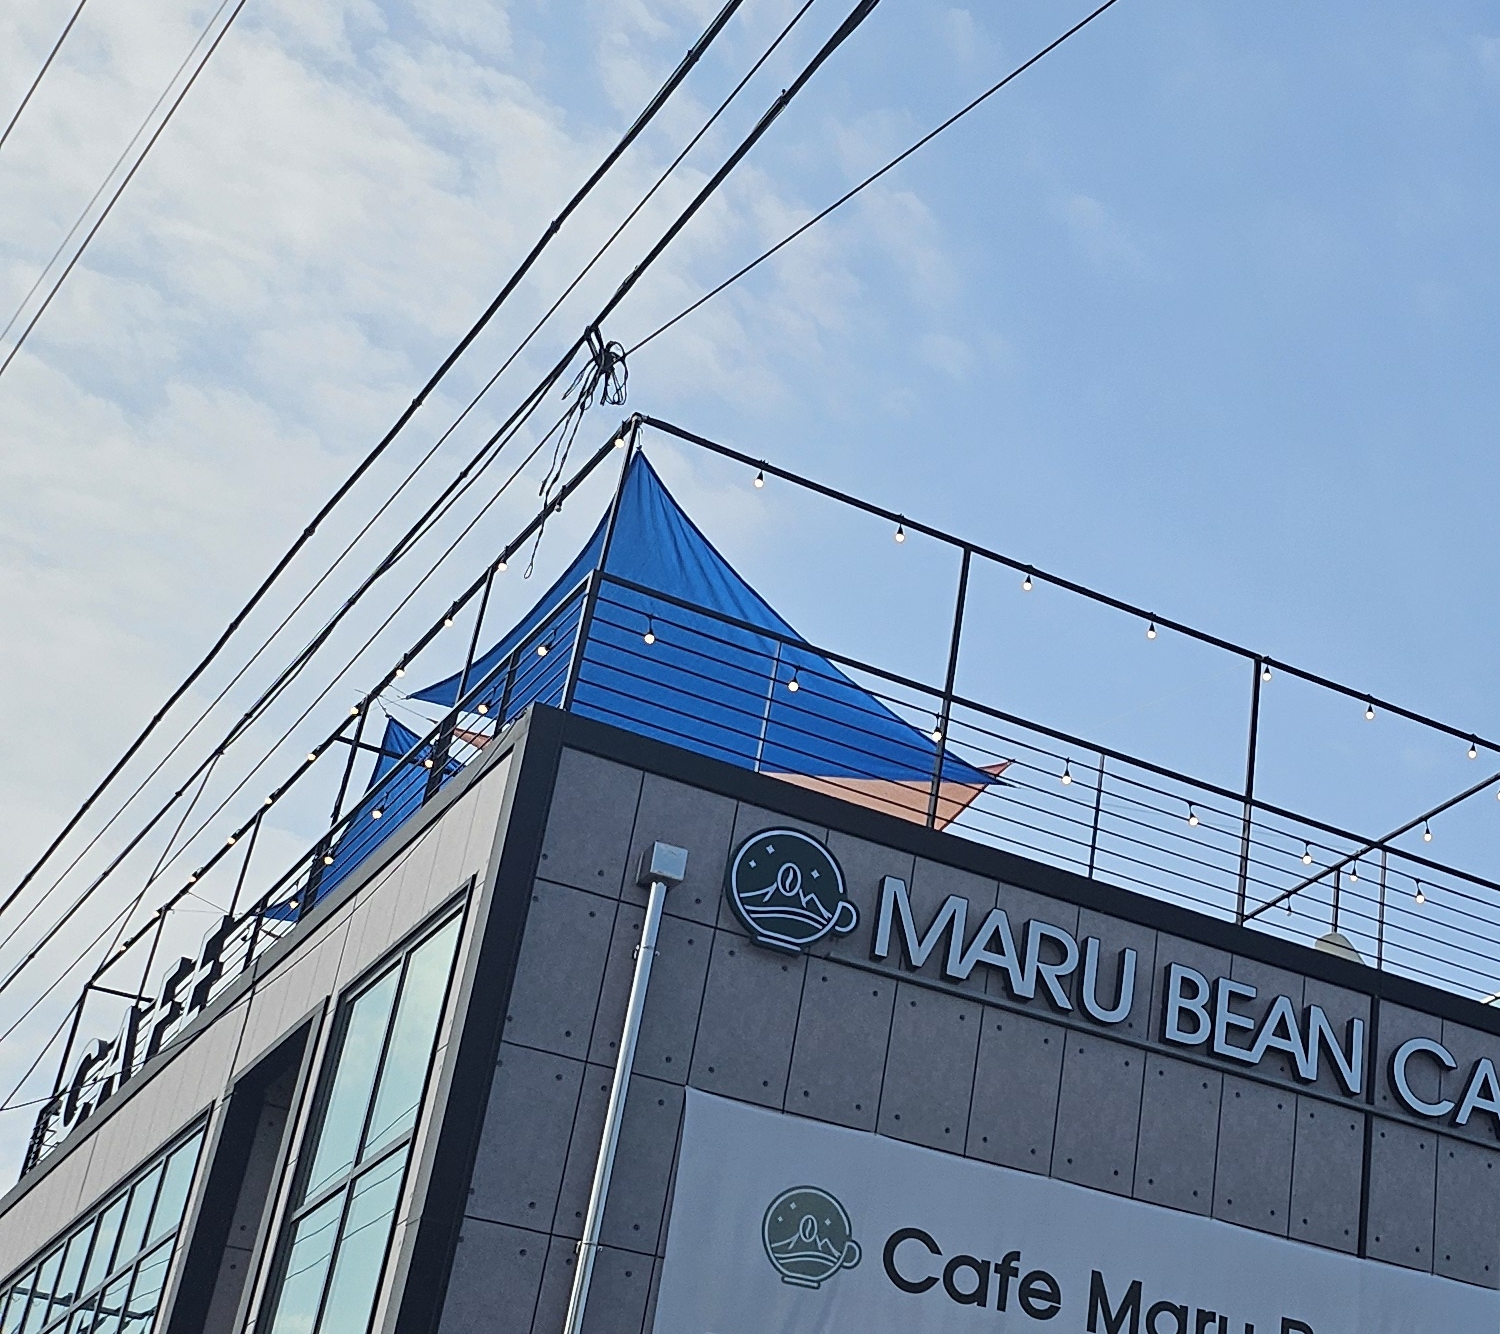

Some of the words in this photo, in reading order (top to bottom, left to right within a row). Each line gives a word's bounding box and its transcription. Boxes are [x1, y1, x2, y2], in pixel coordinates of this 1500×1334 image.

[872, 875, 1137, 1025] MARU
[1162, 962, 1365, 1095] BEAN
[883, 1226, 1062, 1320] Cafe
